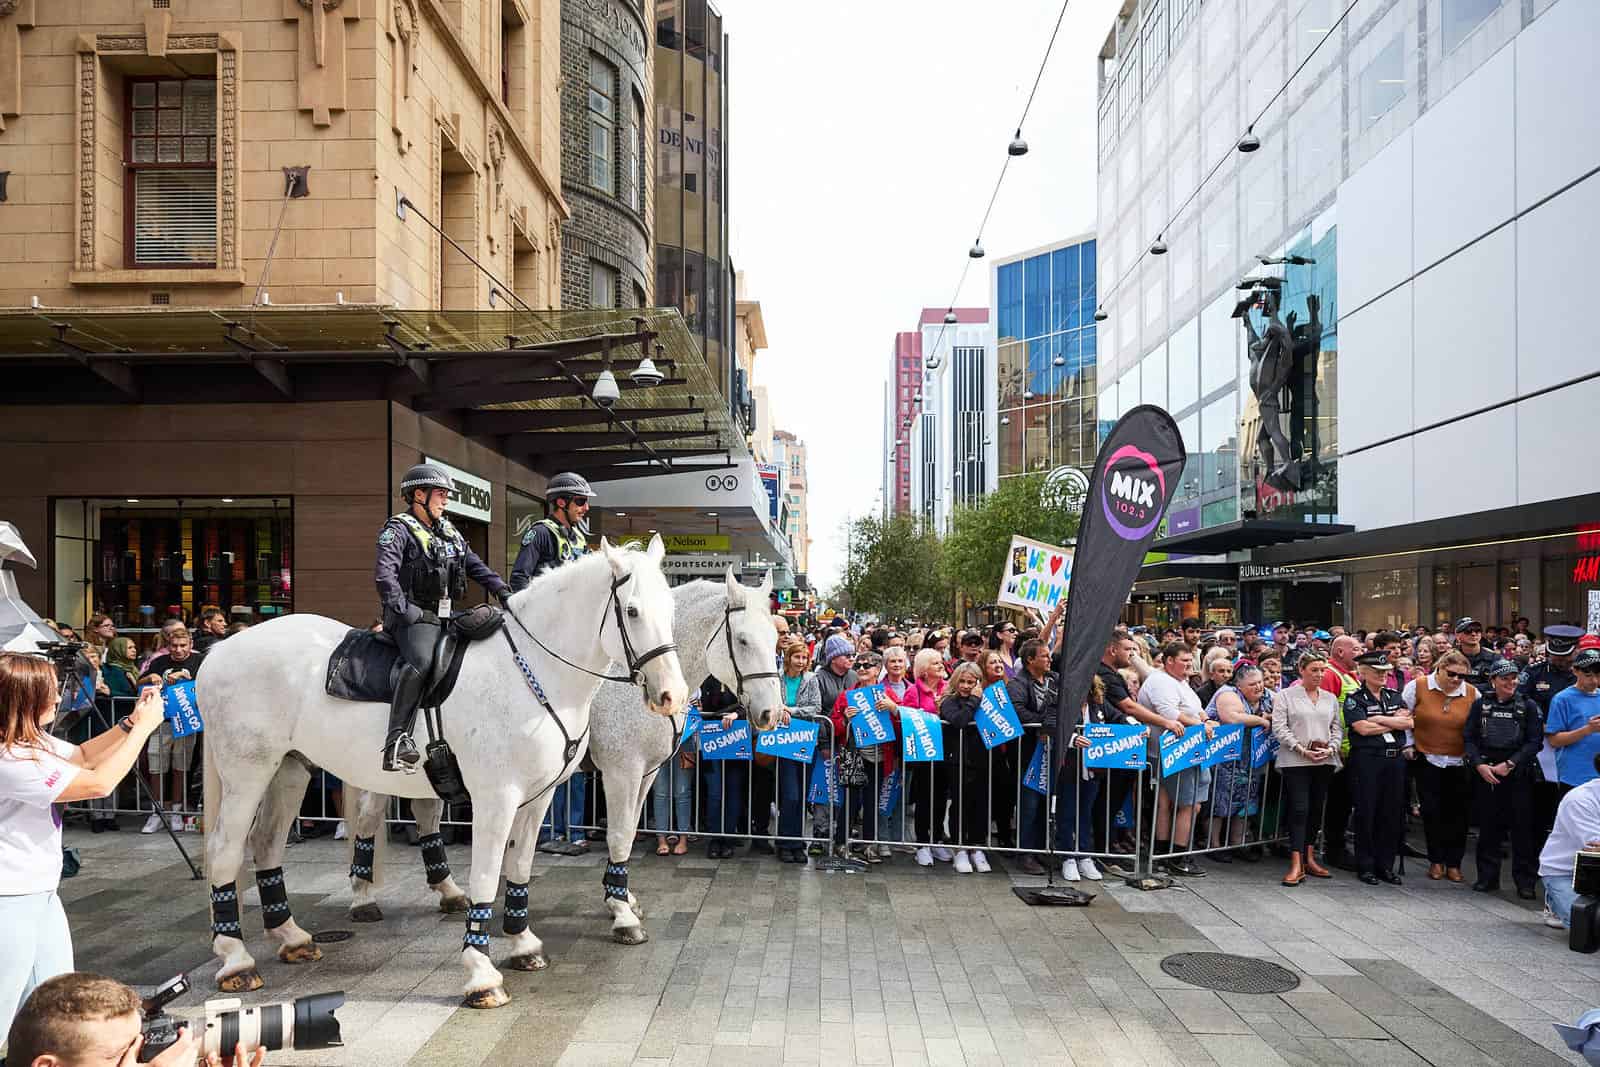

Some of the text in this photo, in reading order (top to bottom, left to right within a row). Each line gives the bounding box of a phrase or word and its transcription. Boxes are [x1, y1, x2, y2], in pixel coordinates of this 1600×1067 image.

[660, 128, 719, 165] DENTST
[1110, 470, 1156, 509] MIX
[1115, 500, 1145, 519] 102.3
[672, 536, 706, 547] Nelson
[662, 560, 733, 568] SPORTSCRAFT
[1029, 549, 1047, 573] WE
[1240, 565, 1270, 577] RUNDLE
[174, 686, 195, 718] SAMMY
[188, 716, 201, 731] GO
[853, 692, 871, 715] OUR
[865, 711, 887, 740] HERO
[989, 711, 1015, 737] HERO
[703, 742, 717, 753] GO
[719, 728, 748, 748] SAMMY
[760, 730, 815, 746] GO SAMMY
[920, 733, 937, 758] OUR
[1087, 746, 1104, 760] GO
[1104, 735, 1144, 755] SAMMY
[1164, 754, 1175, 768] GO
[1174, 731, 1203, 759] SAMMY
[1205, 749, 1211, 760] O
[1210, 730, 1241, 753] SAMMY
